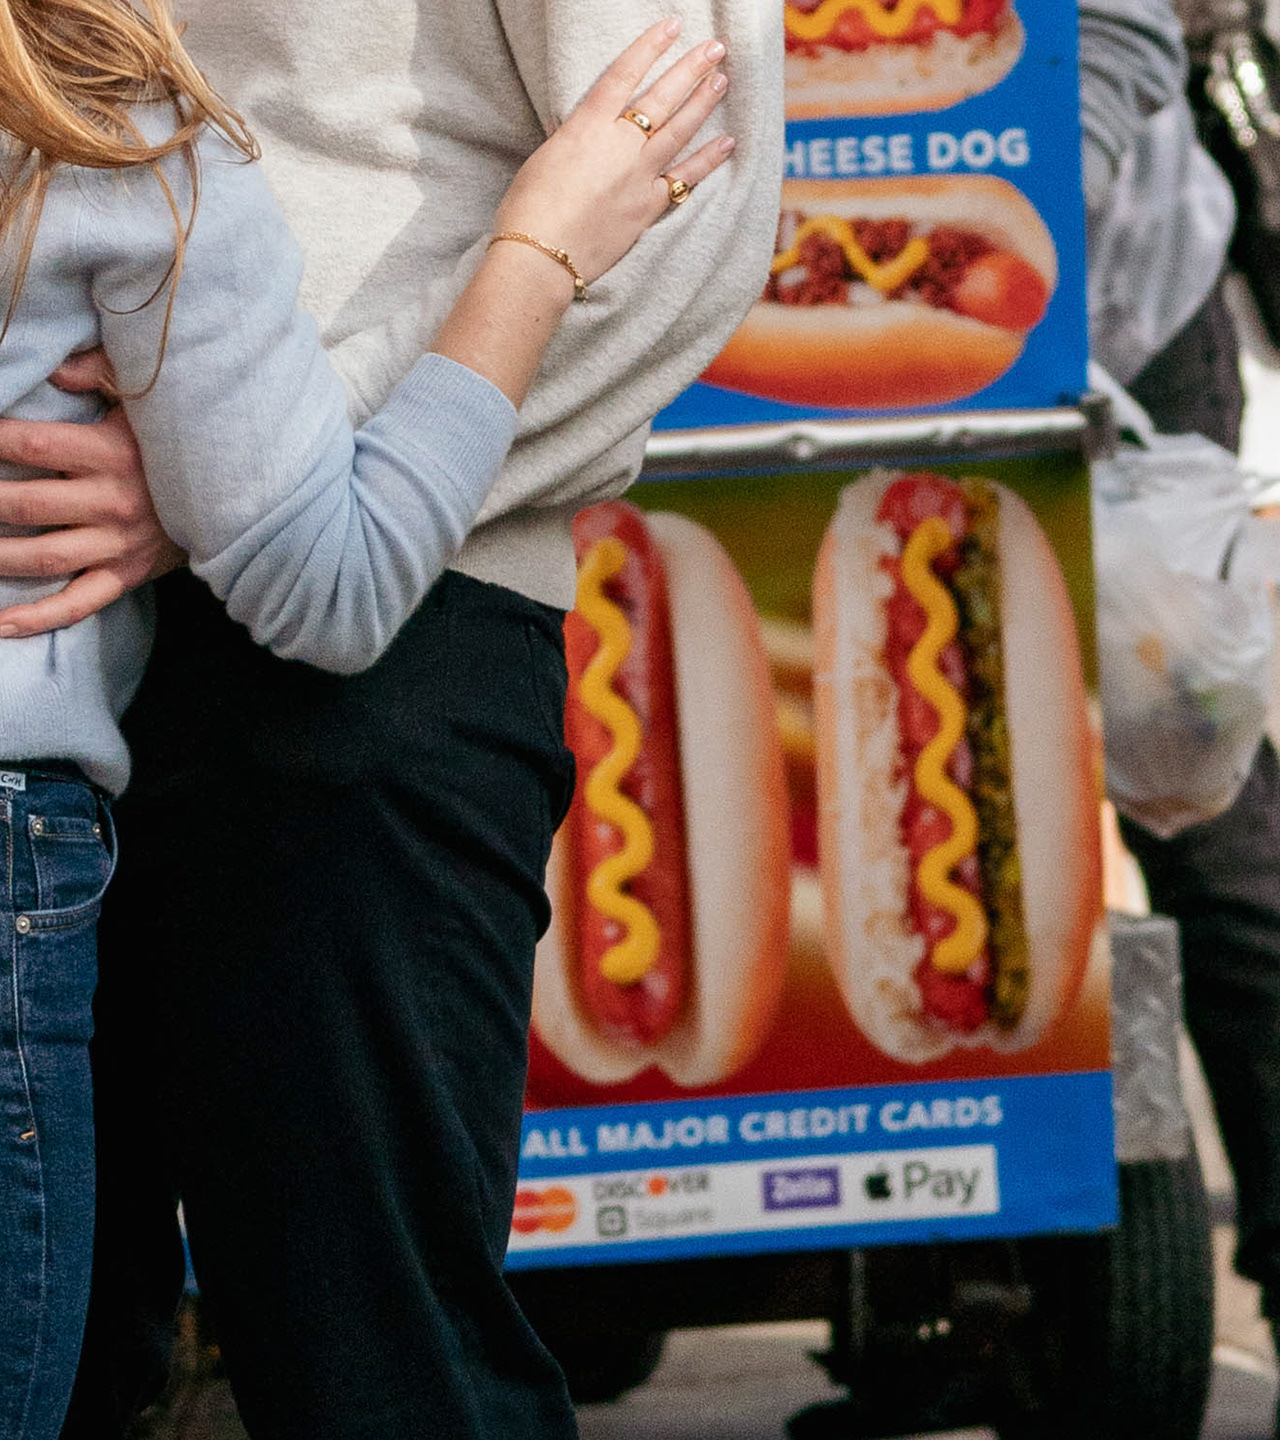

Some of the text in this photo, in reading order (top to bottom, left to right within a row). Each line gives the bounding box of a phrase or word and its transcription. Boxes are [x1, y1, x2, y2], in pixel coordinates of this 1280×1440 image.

[784, 127, 1030, 176] HEESE DOG
[521, 1095, 1004, 1159] ALL MAJOR CREDIT CARDS
[902, 1160, 982, 1206] Pay
